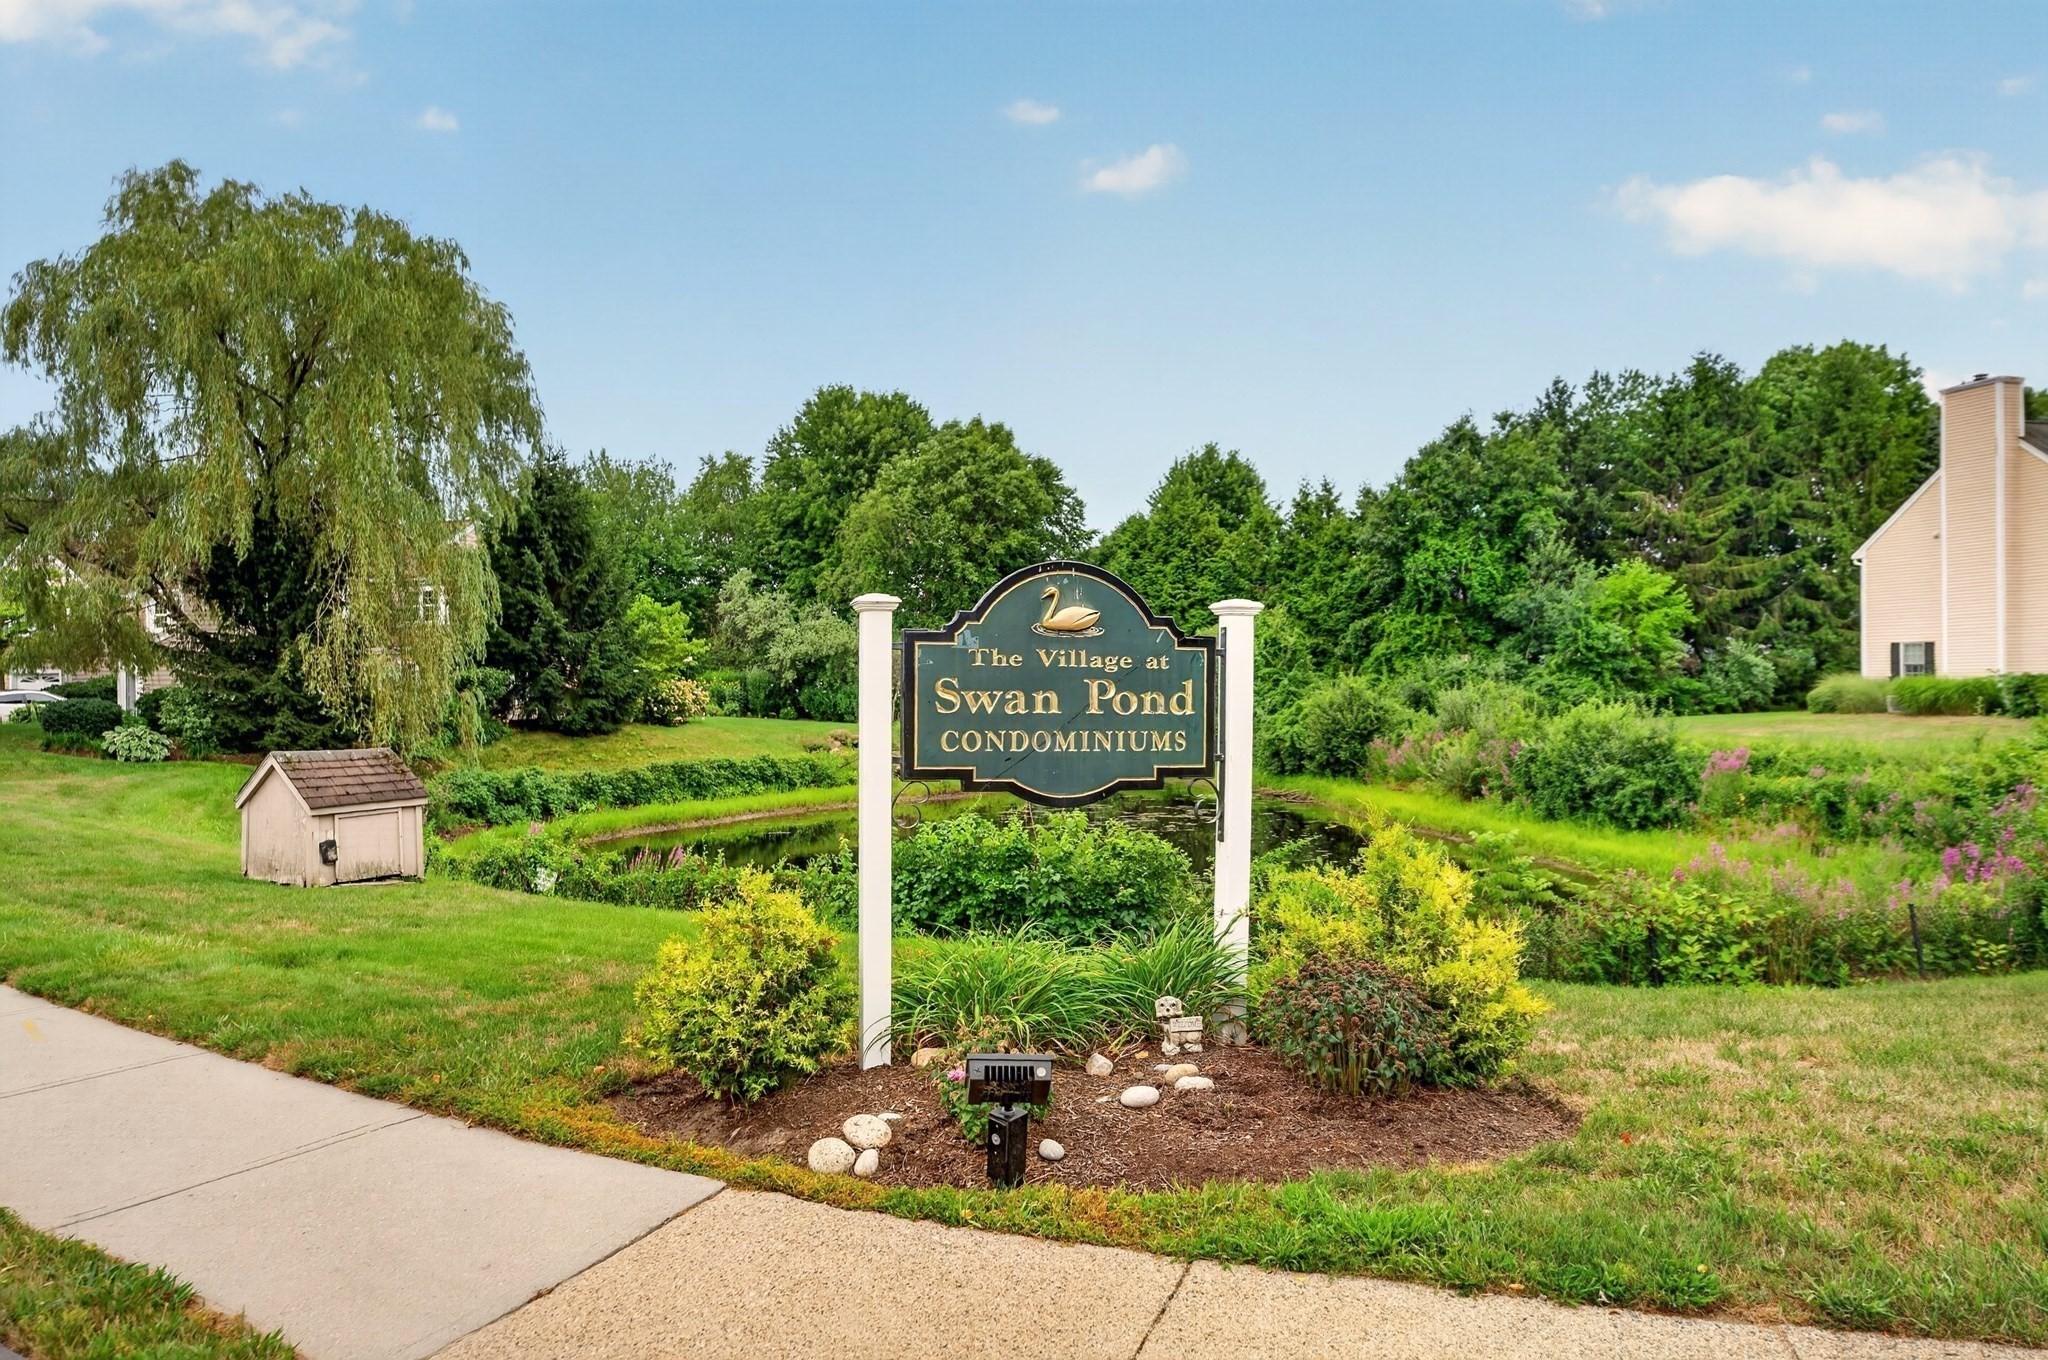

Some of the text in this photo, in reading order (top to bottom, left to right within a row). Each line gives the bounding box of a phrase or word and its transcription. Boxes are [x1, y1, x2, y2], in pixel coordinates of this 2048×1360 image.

[969, 648, 1169, 672] The Village at
[935, 677, 1195, 715] Swan Pond
[941, 730, 1187, 752] CONDOMINIUMS
